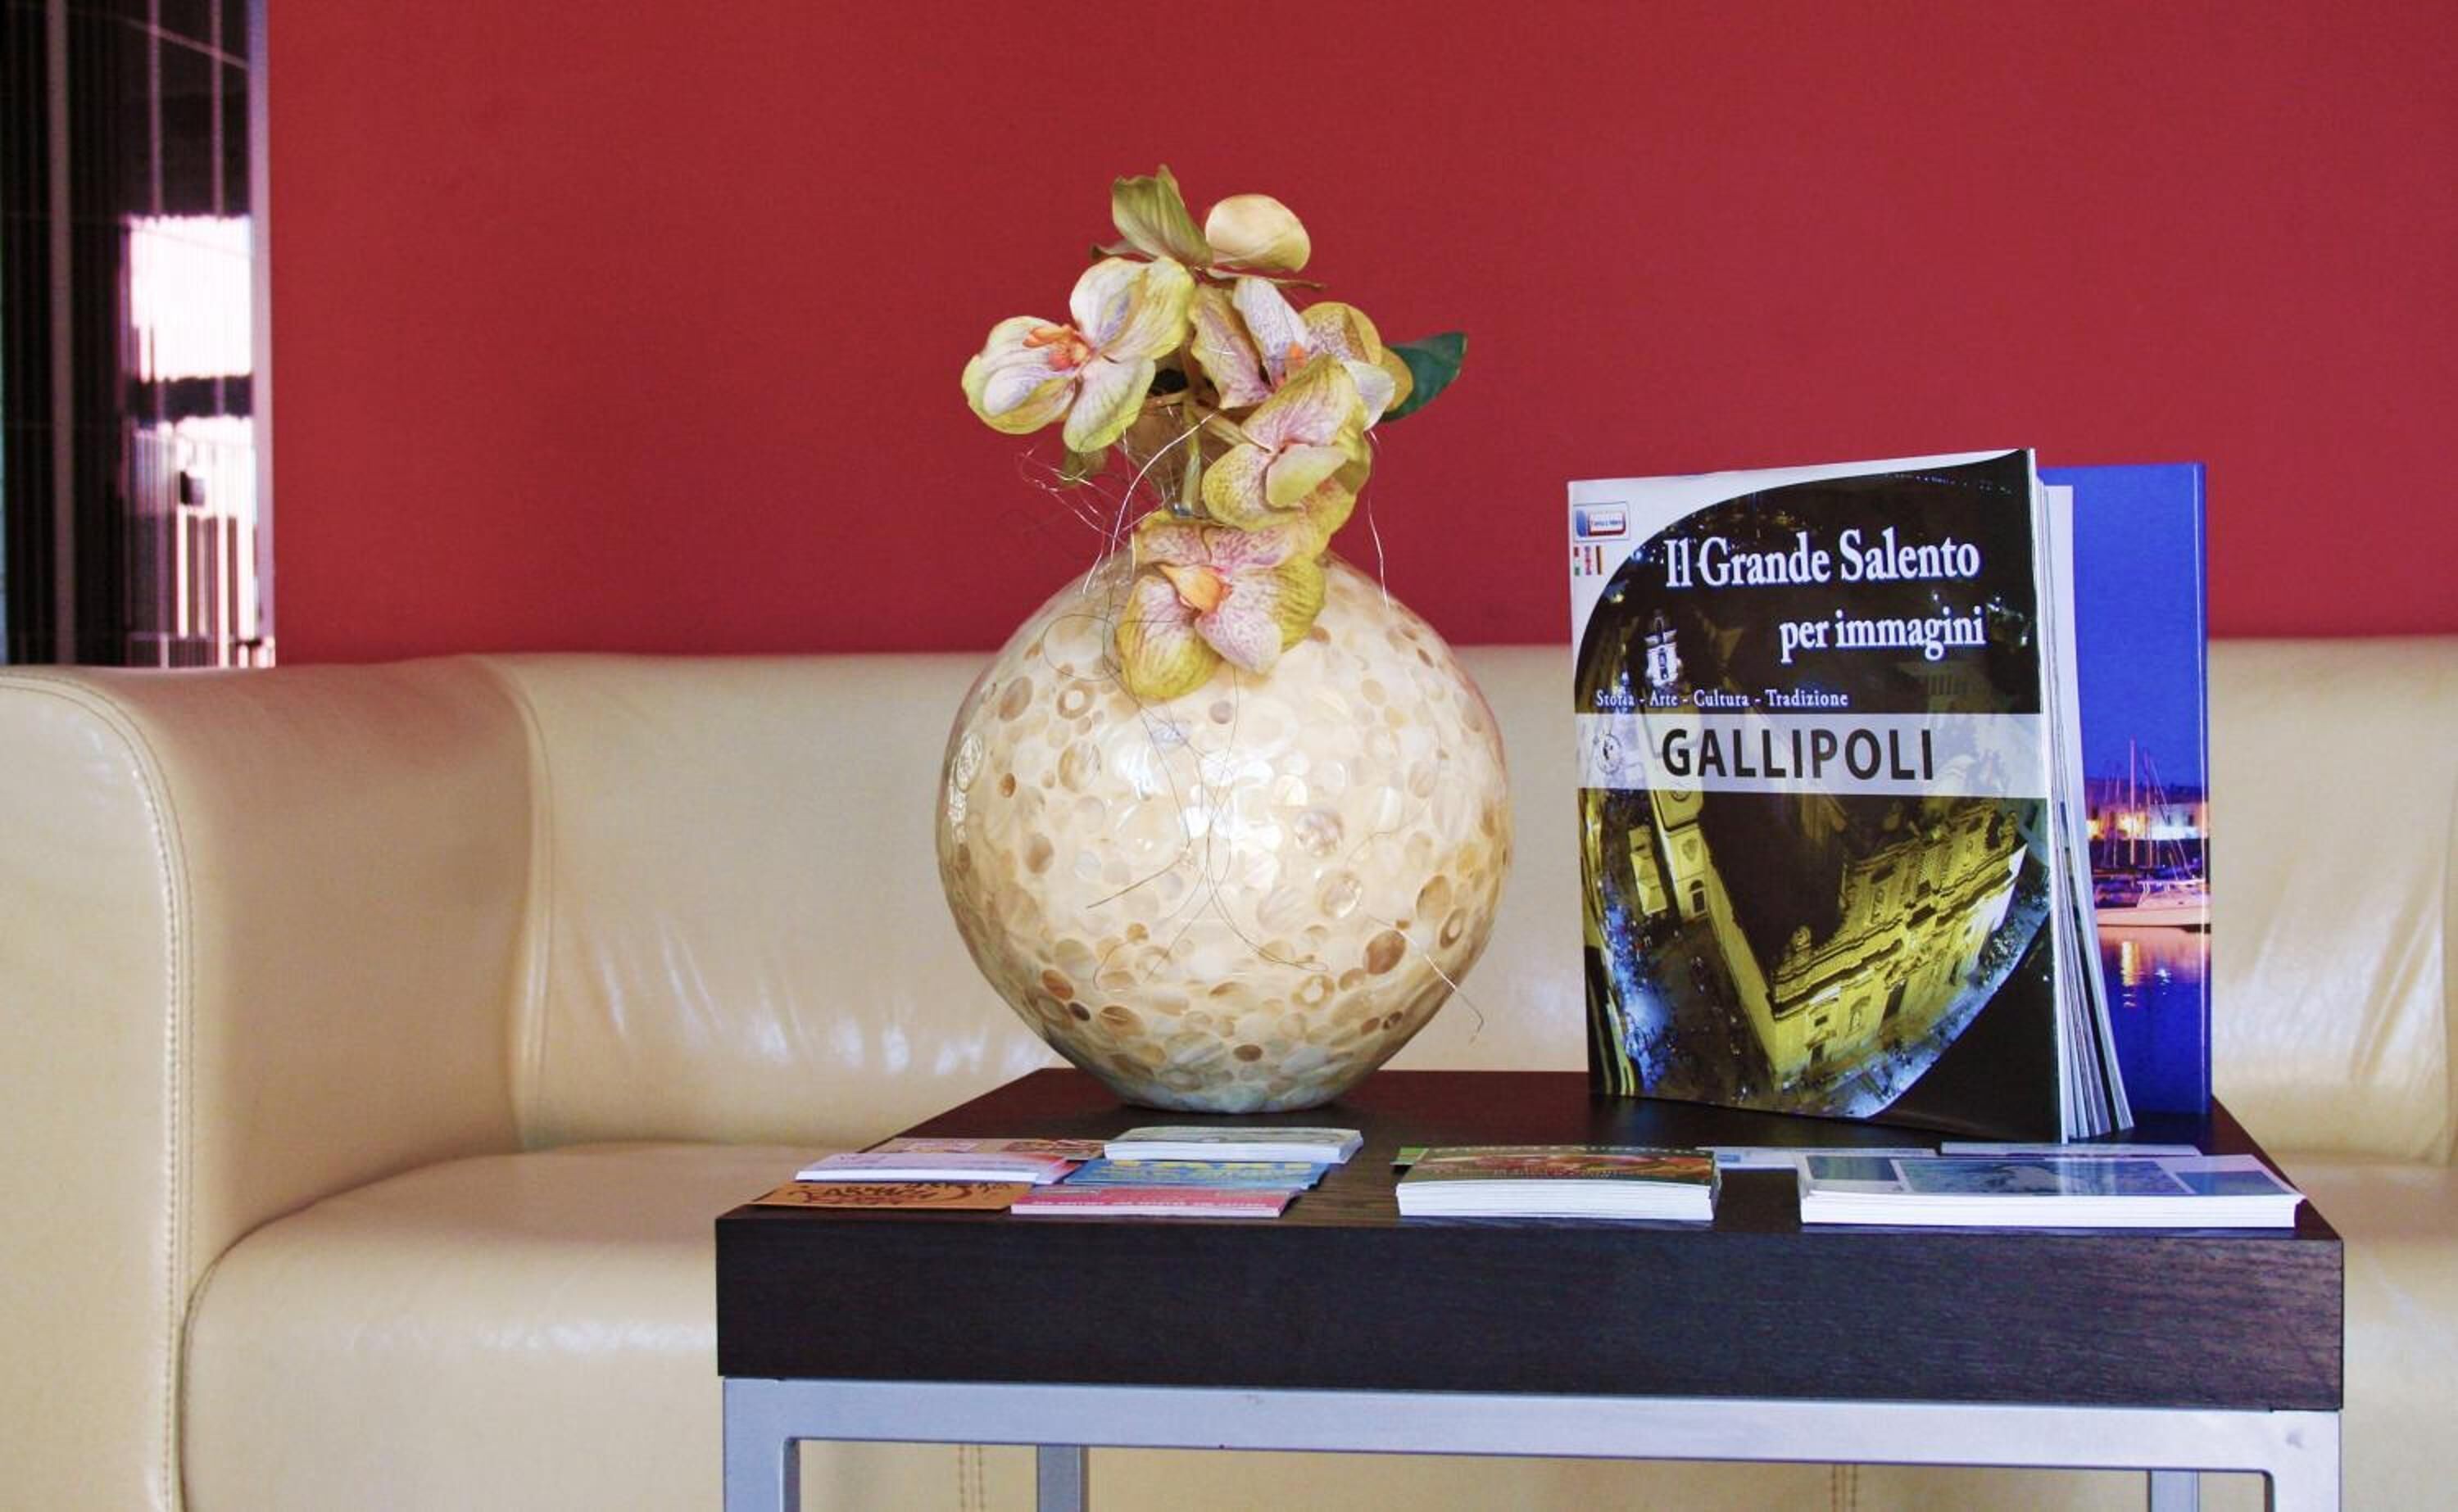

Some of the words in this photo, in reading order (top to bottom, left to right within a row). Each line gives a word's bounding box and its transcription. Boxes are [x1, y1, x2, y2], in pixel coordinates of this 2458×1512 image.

[1664, 537, 1694, 588] Il
[1698, 532, 1831, 587] Grande
[1839, 526, 1981, 582] Salento
[1779, 620, 1830, 663] per
[1834, 606, 1987, 660] immagini
[1596, 690, 1635, 707] Storia
[1649, 690, 1679, 707] Arte
[1693, 689, 1750, 707] Cultura
[1764, 689, 1849, 708] Tradizione
[1662, 727, 1934, 781] GALLIPOLI
